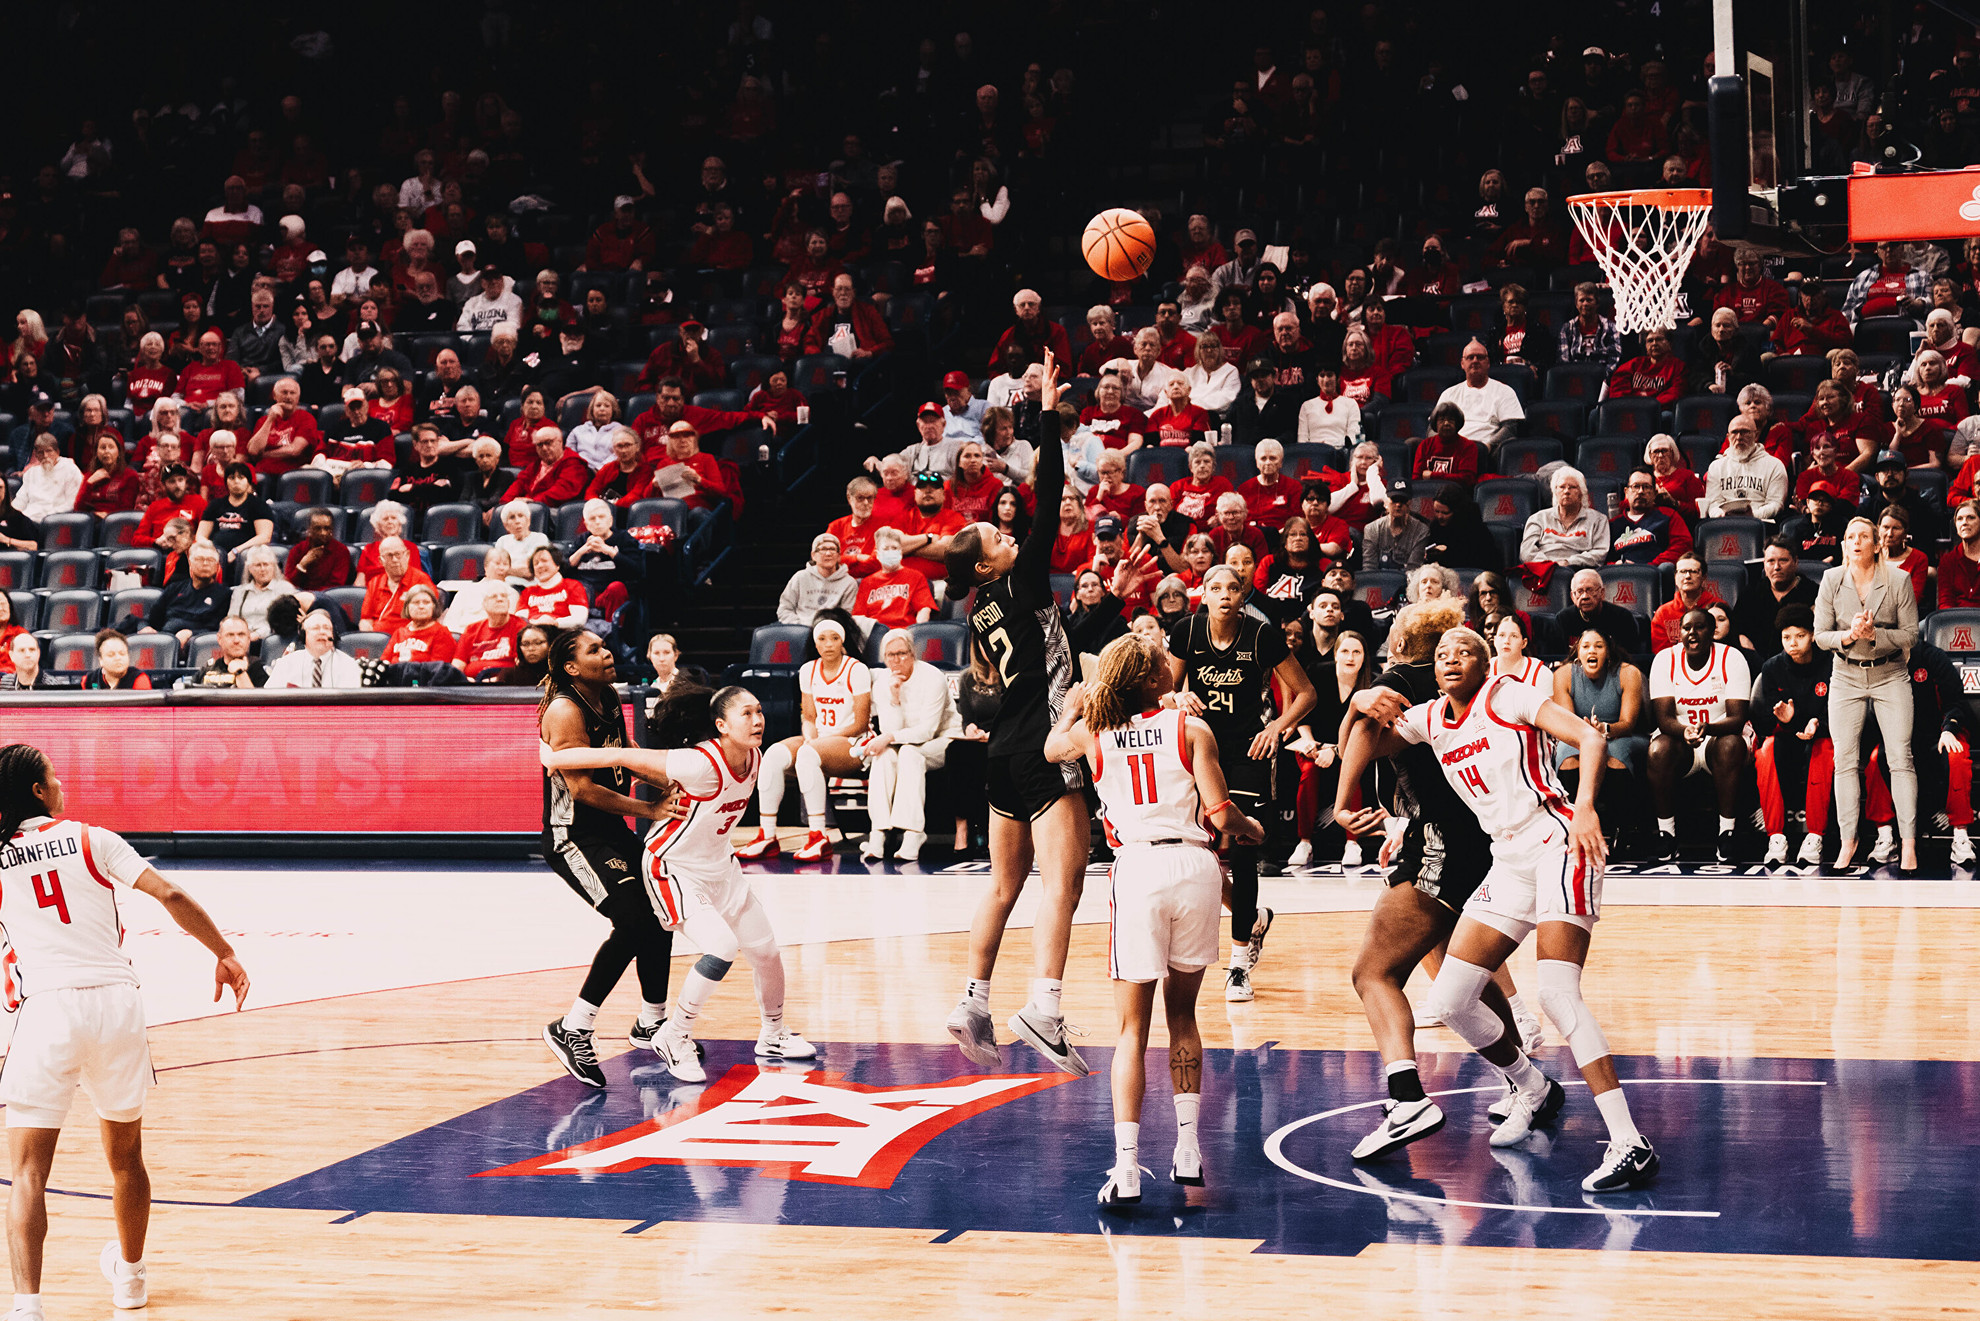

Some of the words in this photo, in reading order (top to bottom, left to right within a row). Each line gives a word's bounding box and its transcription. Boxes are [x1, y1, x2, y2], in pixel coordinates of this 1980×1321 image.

[1650, 1, 1662, 17] 4
[1561, 135, 1584, 154] A
[471, 309, 508, 325] ARIZONA
[130, 378, 163, 393] ARIZONA
[1720, 475, 1764, 492] ARIZONA
[1718, 534, 1743, 556] A
[867, 584, 910, 605] ARIZONA
[1266, 573, 1304, 602] A
[1613, 582, 1638, 605] A
[1950, 627, 1976, 650] A
[988, 626, 1020, 689] 2
[1196, 665, 1245, 689] Knights
[1207, 690, 1234, 714] 24
[1677, 695, 1719, 706] ARIZONA
[821, 708, 836, 727] 33
[1687, 709, 1710, 726] 20
[1113, 728, 1163, 749] WELCH
[1441, 737, 1490, 766] ARIZONA
[48, 735, 404, 808] ILDCATS!
[1127, 752, 1159, 806] 11
[1457, 764, 1490, 799] 14
[716, 814, 738, 835] 3
[0, 837, 78, 870] CORNFIELD
[31, 868, 72, 925] 4
[1472, 884, 1492, 903] A
